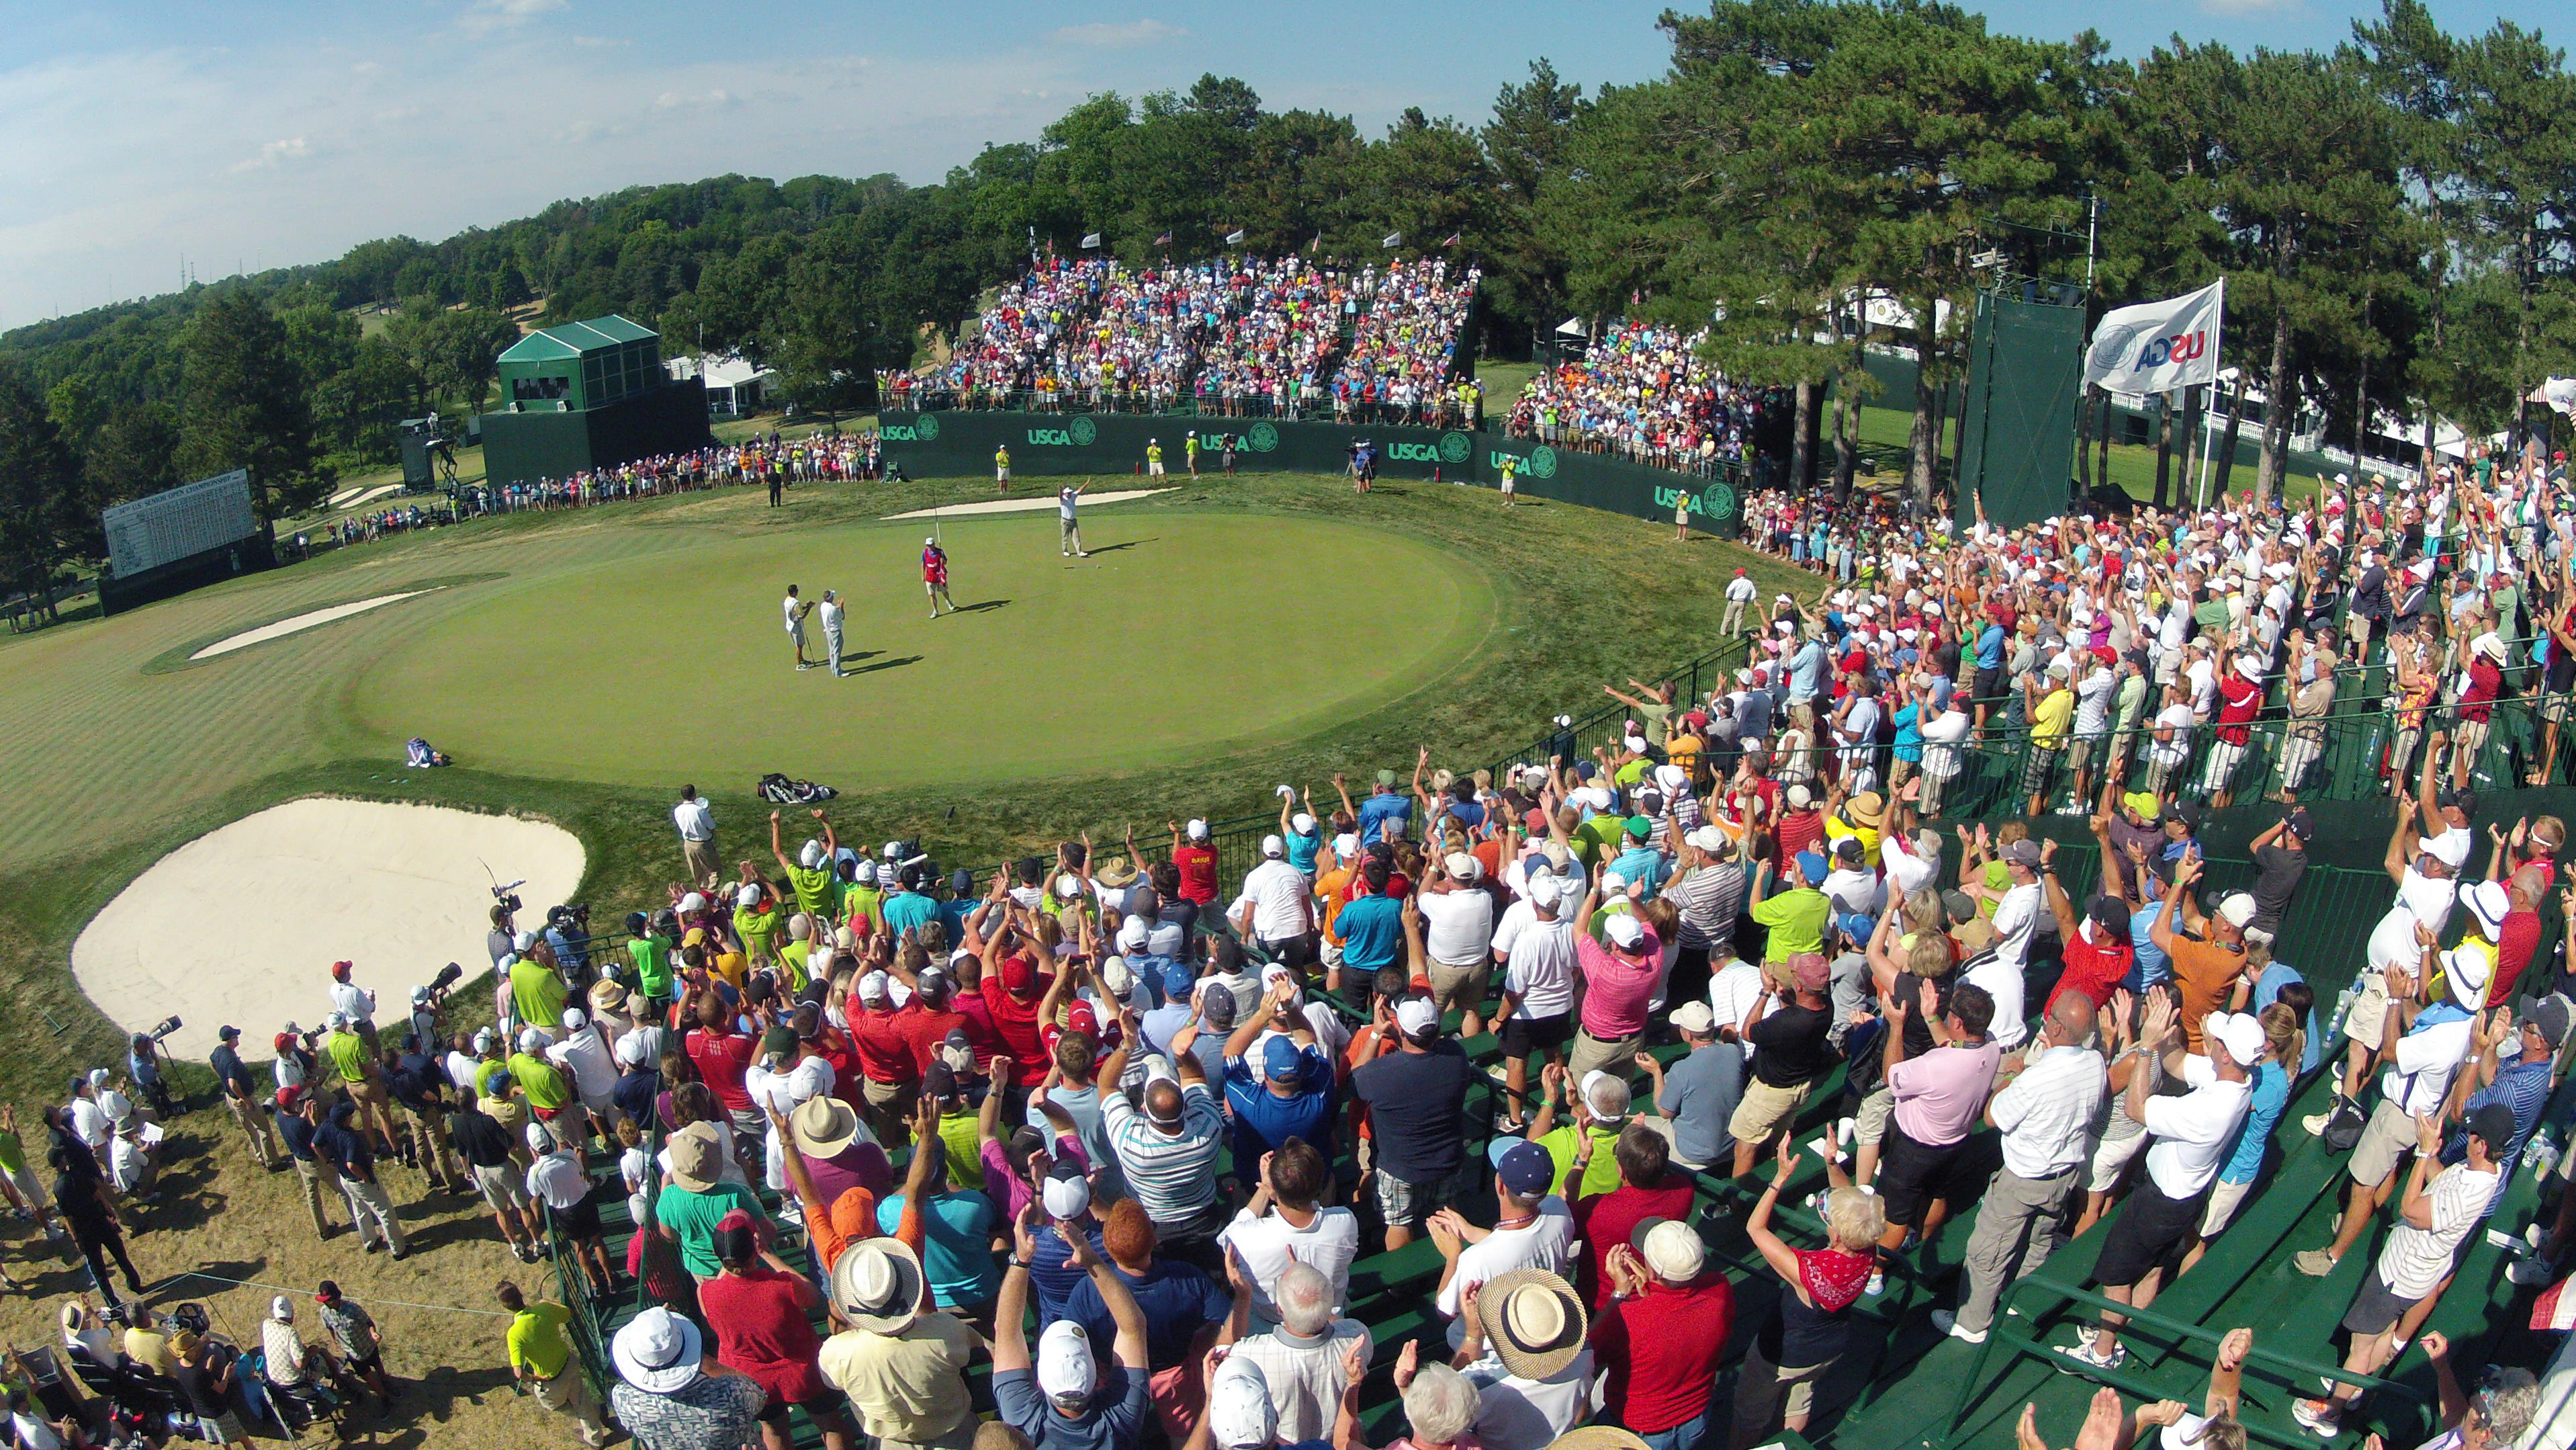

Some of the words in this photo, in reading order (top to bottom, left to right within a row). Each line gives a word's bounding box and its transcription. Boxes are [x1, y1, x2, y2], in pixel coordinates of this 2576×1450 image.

[880, 425, 918, 441] USGA
[1028, 429, 1072, 445] USGA
[1201, 434, 1250, 452] USA
[1388, 443, 1440, 462] USGA
[1654, 485, 1703, 515] USA
